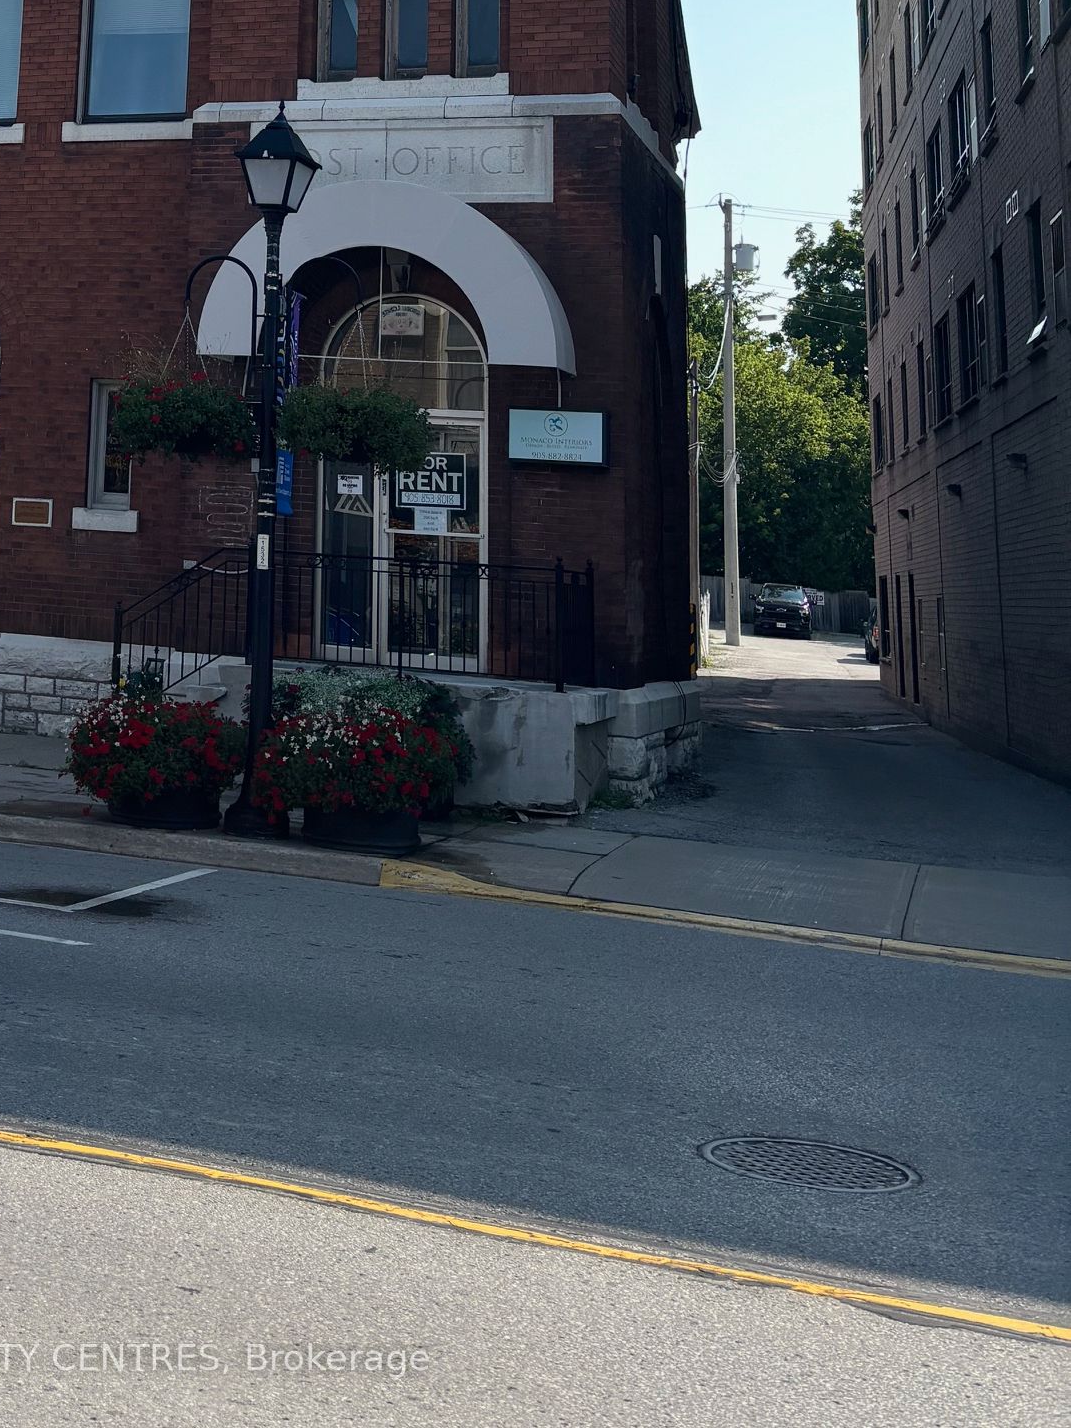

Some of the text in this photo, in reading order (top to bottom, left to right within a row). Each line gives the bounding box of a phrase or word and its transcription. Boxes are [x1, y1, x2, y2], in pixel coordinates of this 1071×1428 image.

[309, 145, 526, 176] ST OFFICE
[520, 436, 554, 445] MONACO
[424, 456, 448, 471] OR
[399, 471, 463, 492] RENT
